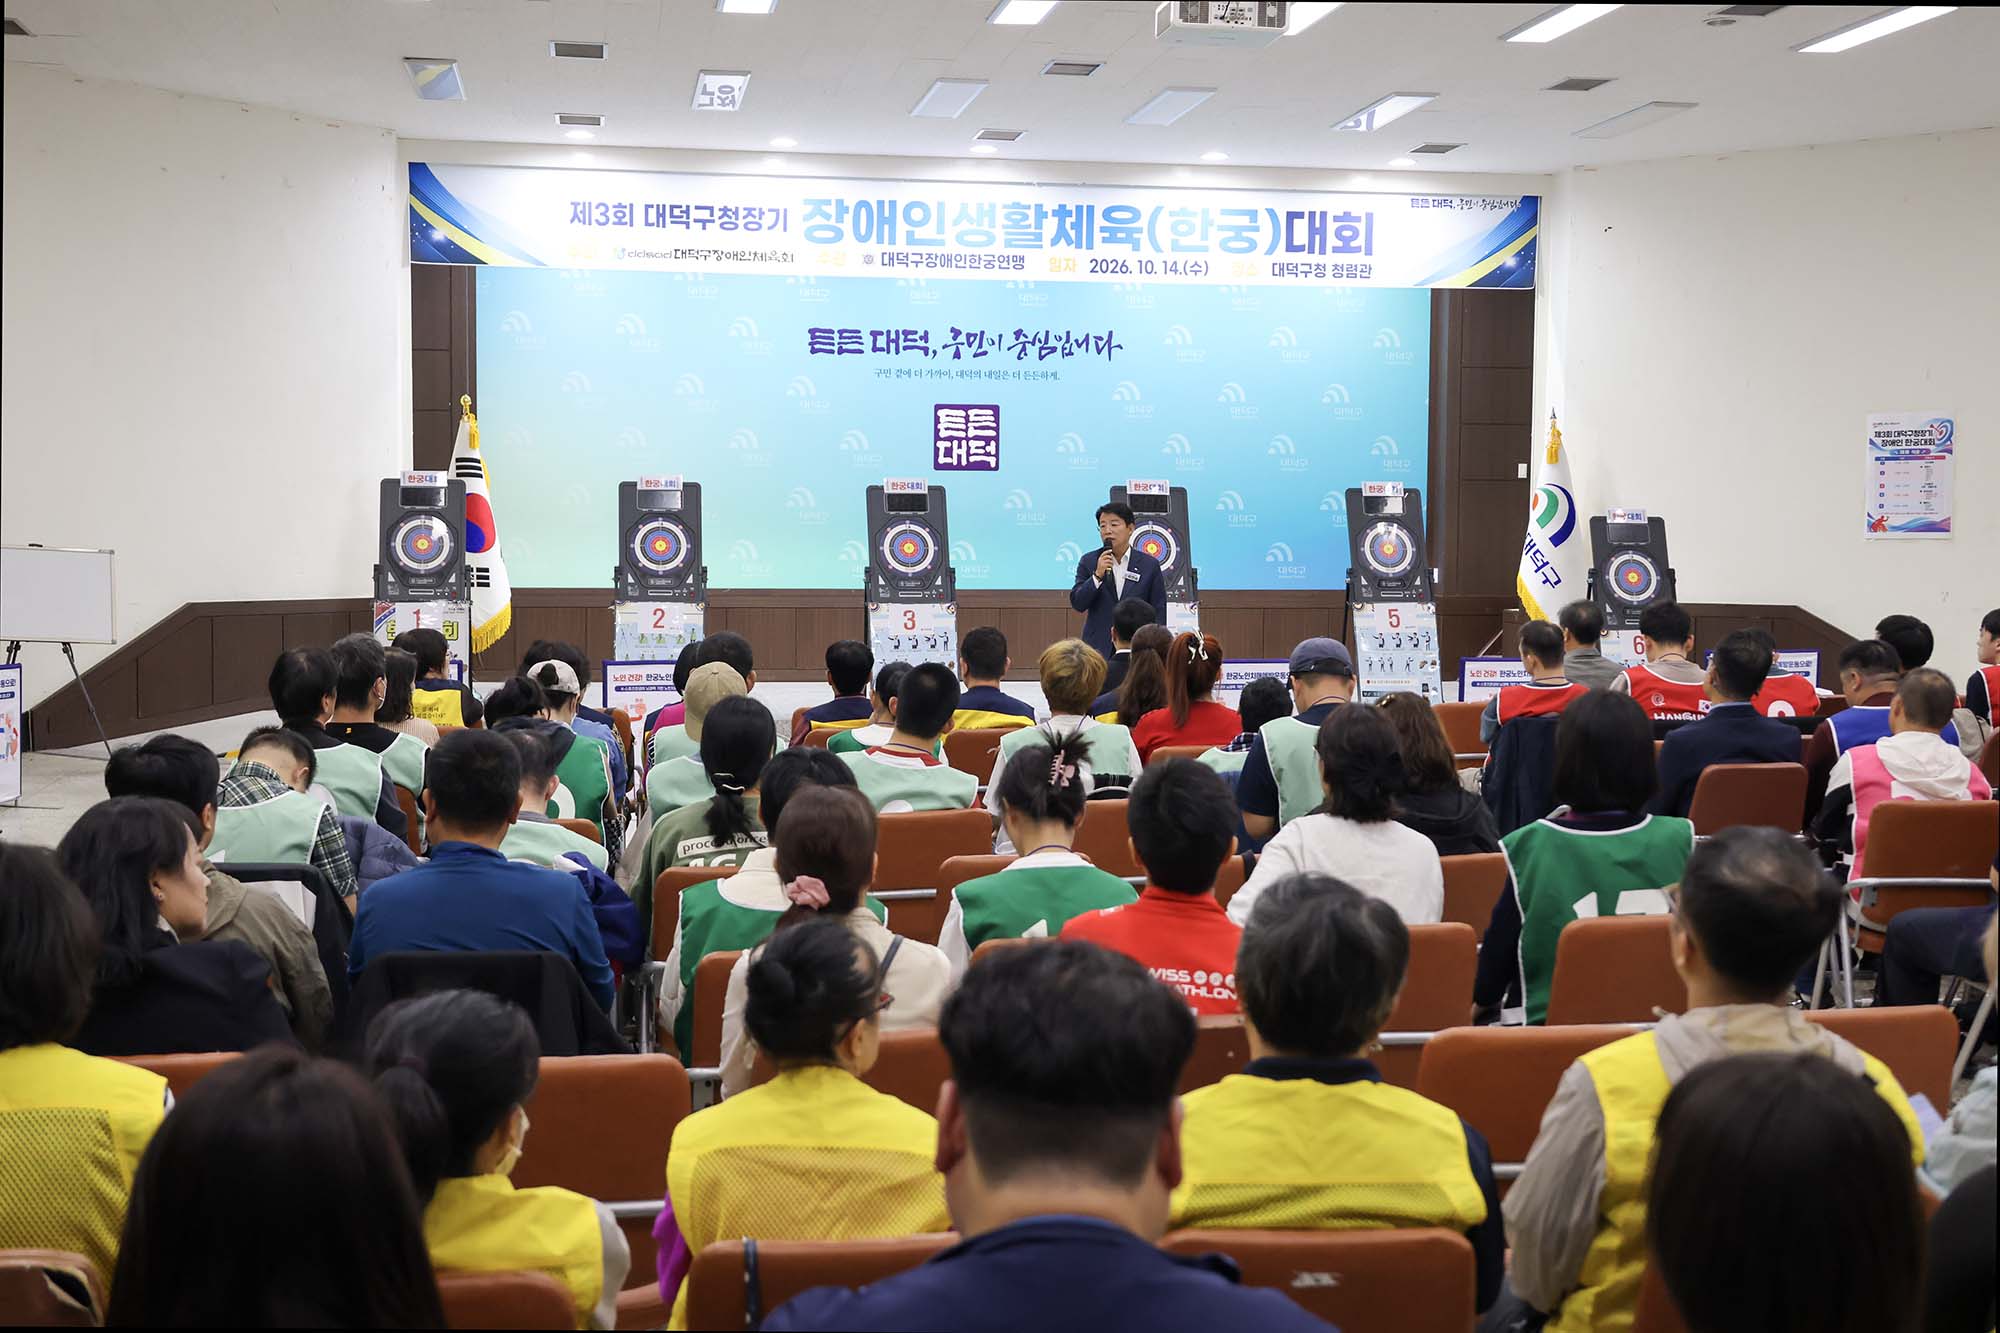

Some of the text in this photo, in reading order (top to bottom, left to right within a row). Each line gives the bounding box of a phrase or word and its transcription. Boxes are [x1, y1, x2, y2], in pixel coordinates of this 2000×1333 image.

[570, 201, 634, 227] 제3회
[643, 203, 788, 232] 대덕구청장기
[673, 248, 794, 263] 대덕구장애인체육회
[881, 251, 1025, 271] 대덕구장애인한궁연맹
[1089, 258, 1132, 275] 2026.
[1137, 260, 1156, 275] 10.
[1162, 260, 1209, 277] 14.(수)
[1272, 262, 1326, 278] 대덕구청
[1331, 263, 1372, 279] 청렴관
[869, 328, 938, 360] 대덕,
[942, 326, 1004, 360] 구민이
[1007, 328, 1124, 361] 중심입니다
[874, 368, 892, 378] 구민
[956, 369, 981, 379] 대덕의
[935, 439, 997, 469] 대덕
[652, 608, 666, 630] 2
[903, 610, 917, 630] 3
[1387, 608, 1401, 628] 5
[1633, 634, 1646, 656] 6
[646, 673, 673, 682] 한궁노인
